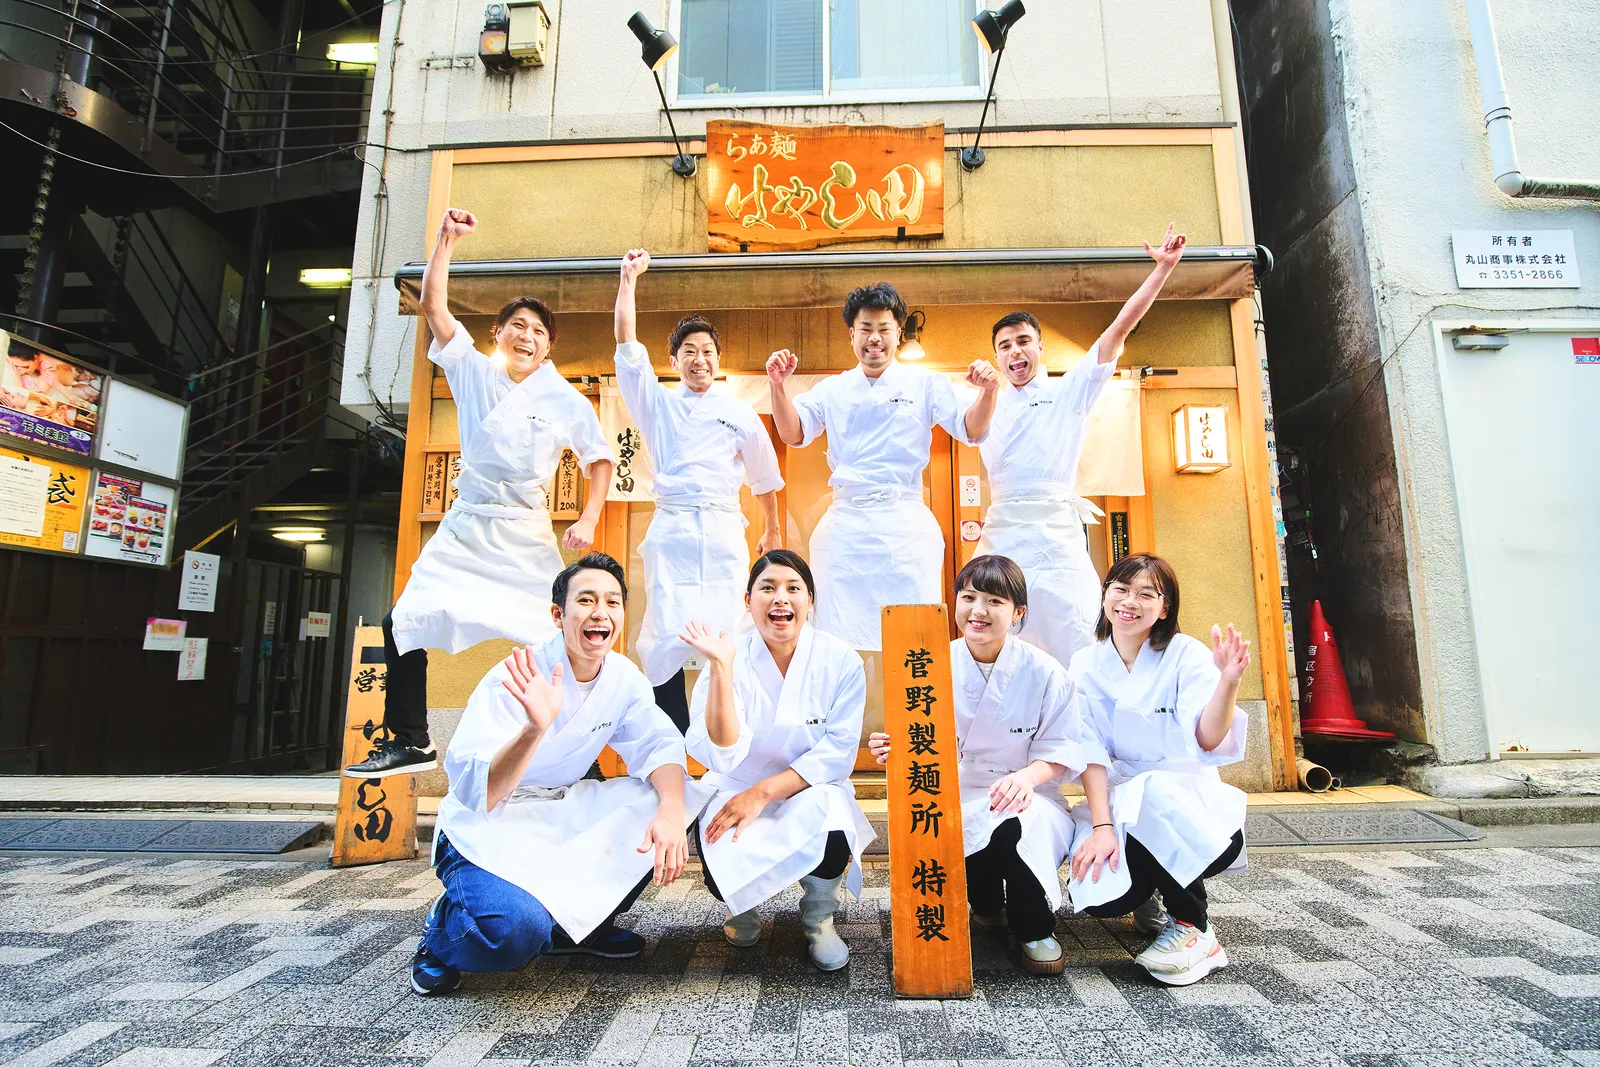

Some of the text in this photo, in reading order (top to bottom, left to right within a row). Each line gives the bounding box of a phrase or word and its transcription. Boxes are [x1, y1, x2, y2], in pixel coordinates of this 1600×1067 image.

[725, 161, 925, 230] はやし田
[1492, 235, 1533, 247] 所有者
[1465, 254, 1567, 265] 丸山商事株式会社
[1493, 269, 1564, 280] 3351-2866
[615, 427, 635, 493] はやし田
[559, 501, 576, 511] 200
[904, 648, 950, 943] 菅野製麺所 特製
